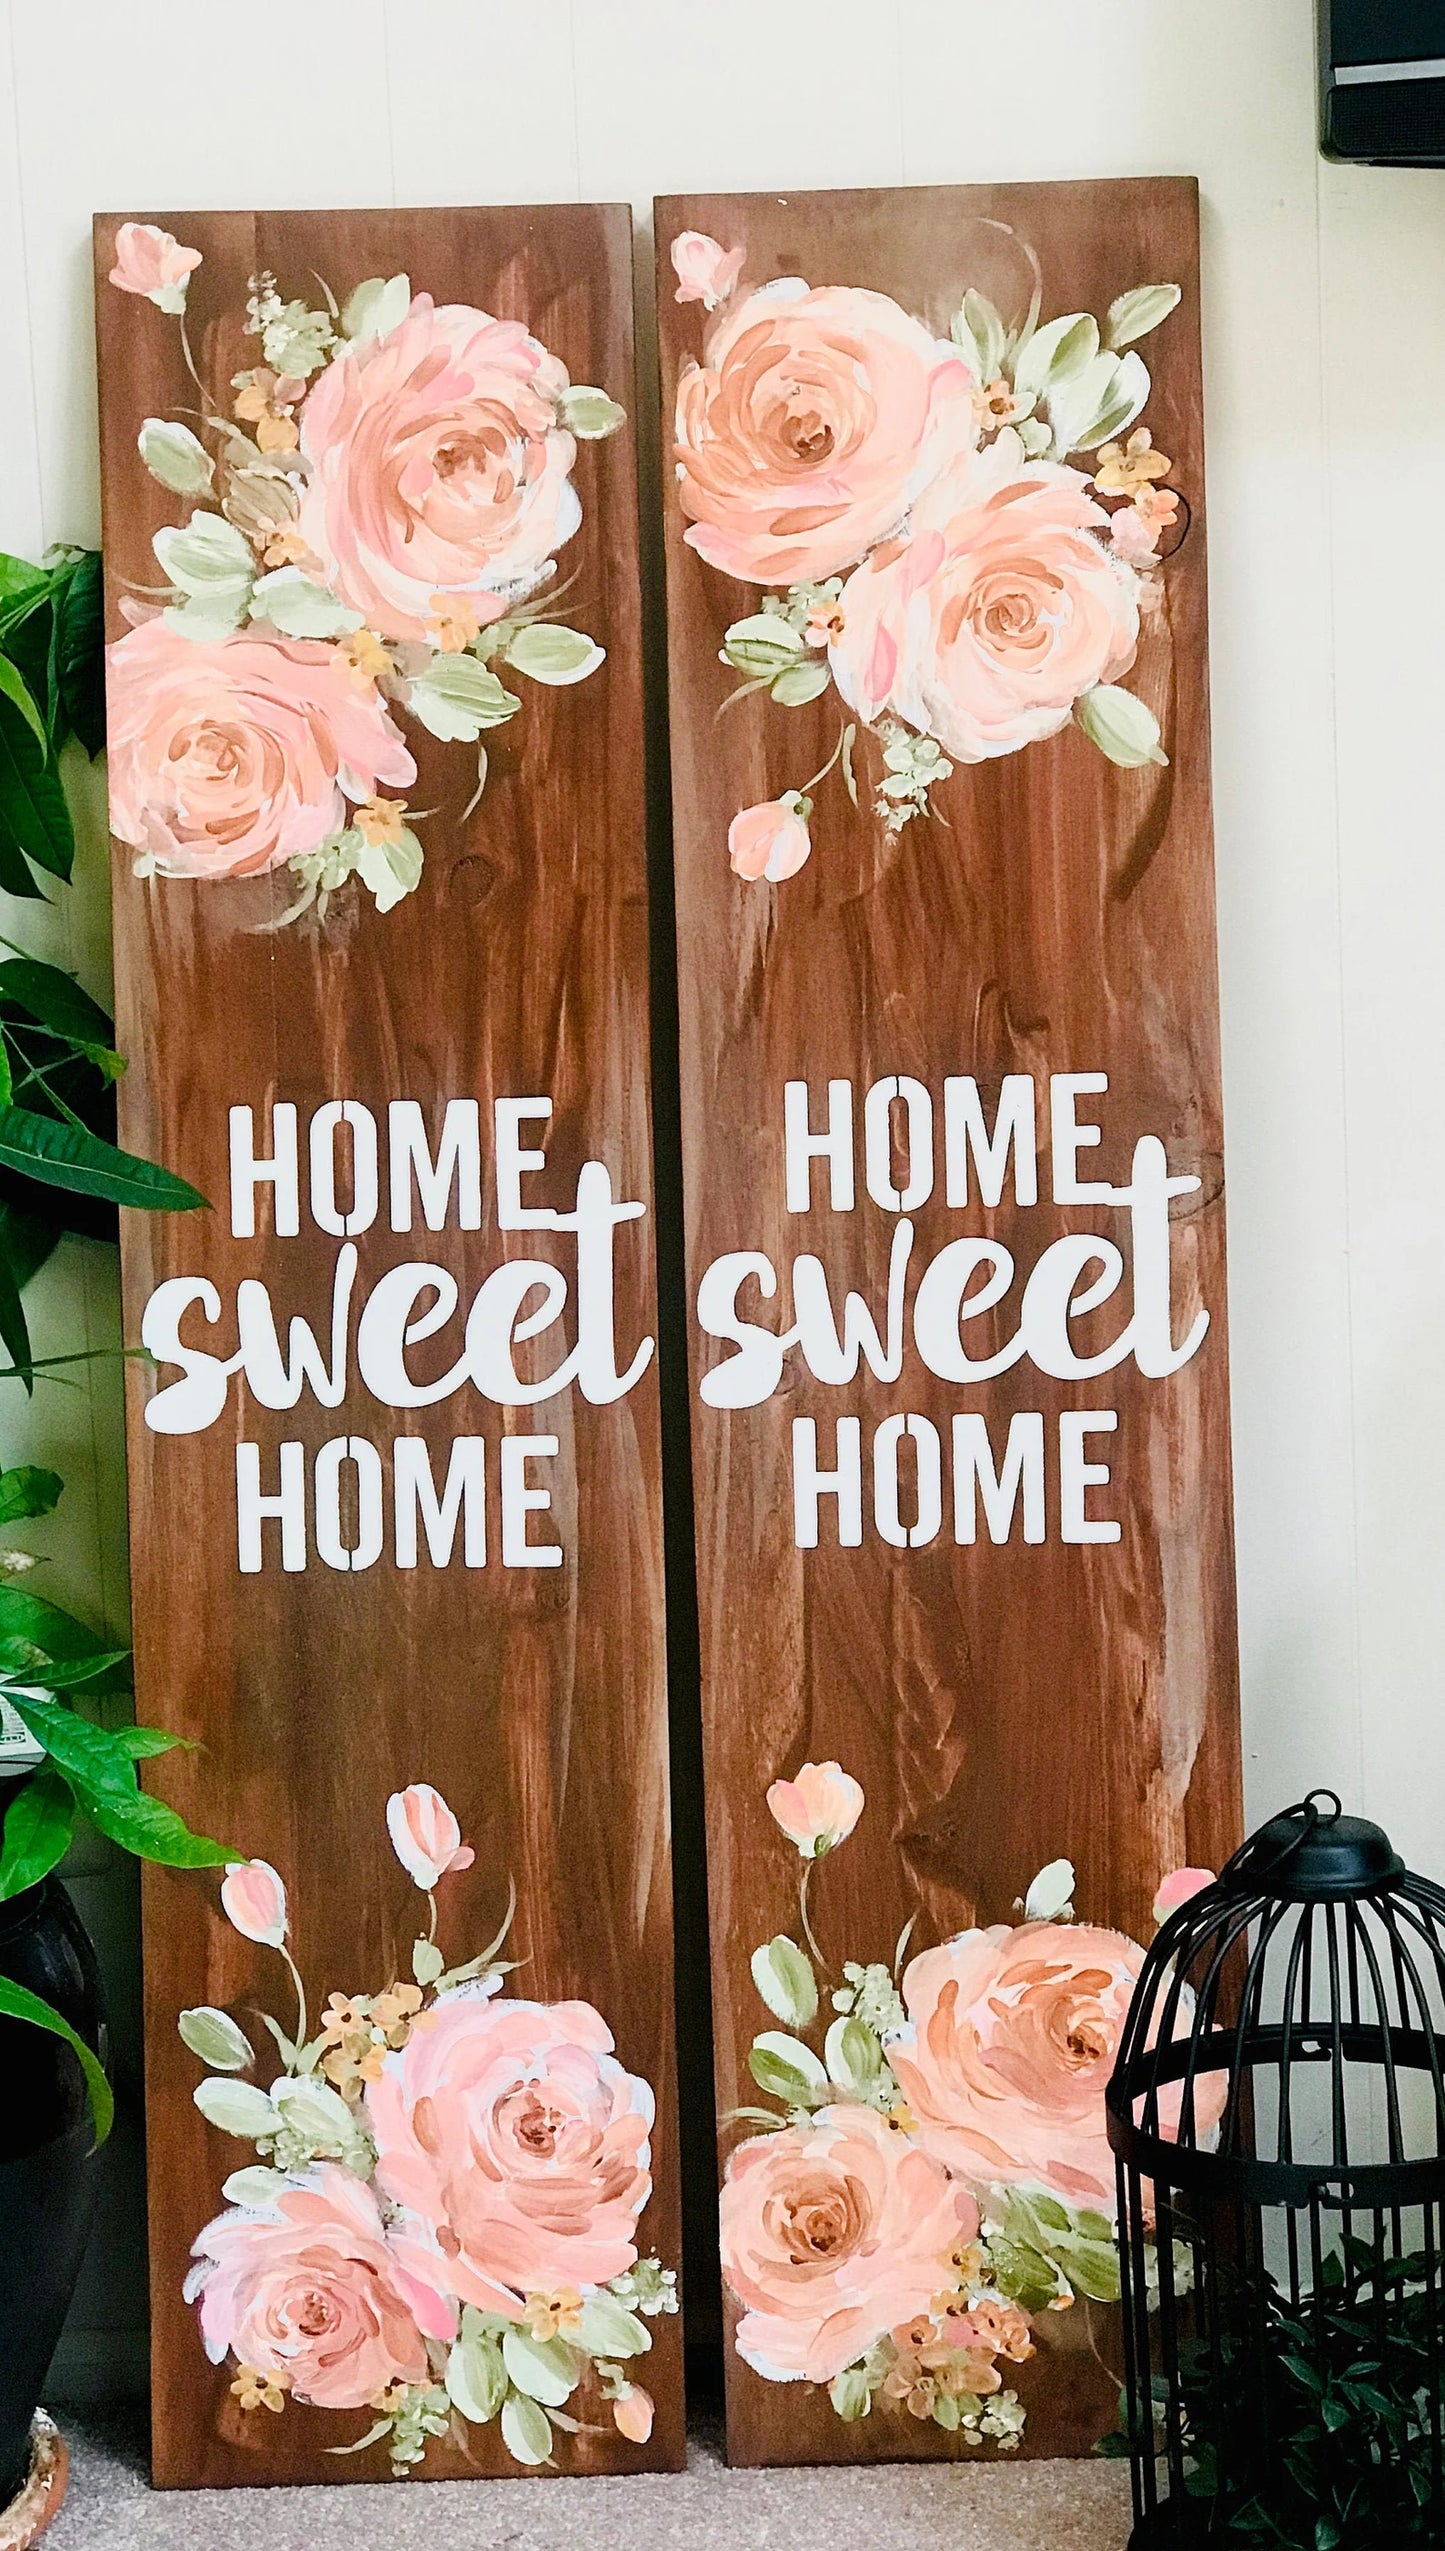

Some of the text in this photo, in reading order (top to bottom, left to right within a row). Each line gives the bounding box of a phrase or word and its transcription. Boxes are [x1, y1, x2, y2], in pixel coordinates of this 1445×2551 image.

[229, 1096, 558, 1238] HOME
[784, 1072, 1111, 1214] HOME
[141, 1160, 655, 1436] sweet
[697, 1135, 1210, 1411] sweet
[236, 1435, 563, 1573] HOME
[792, 1410, 1122, 1549] HOME
